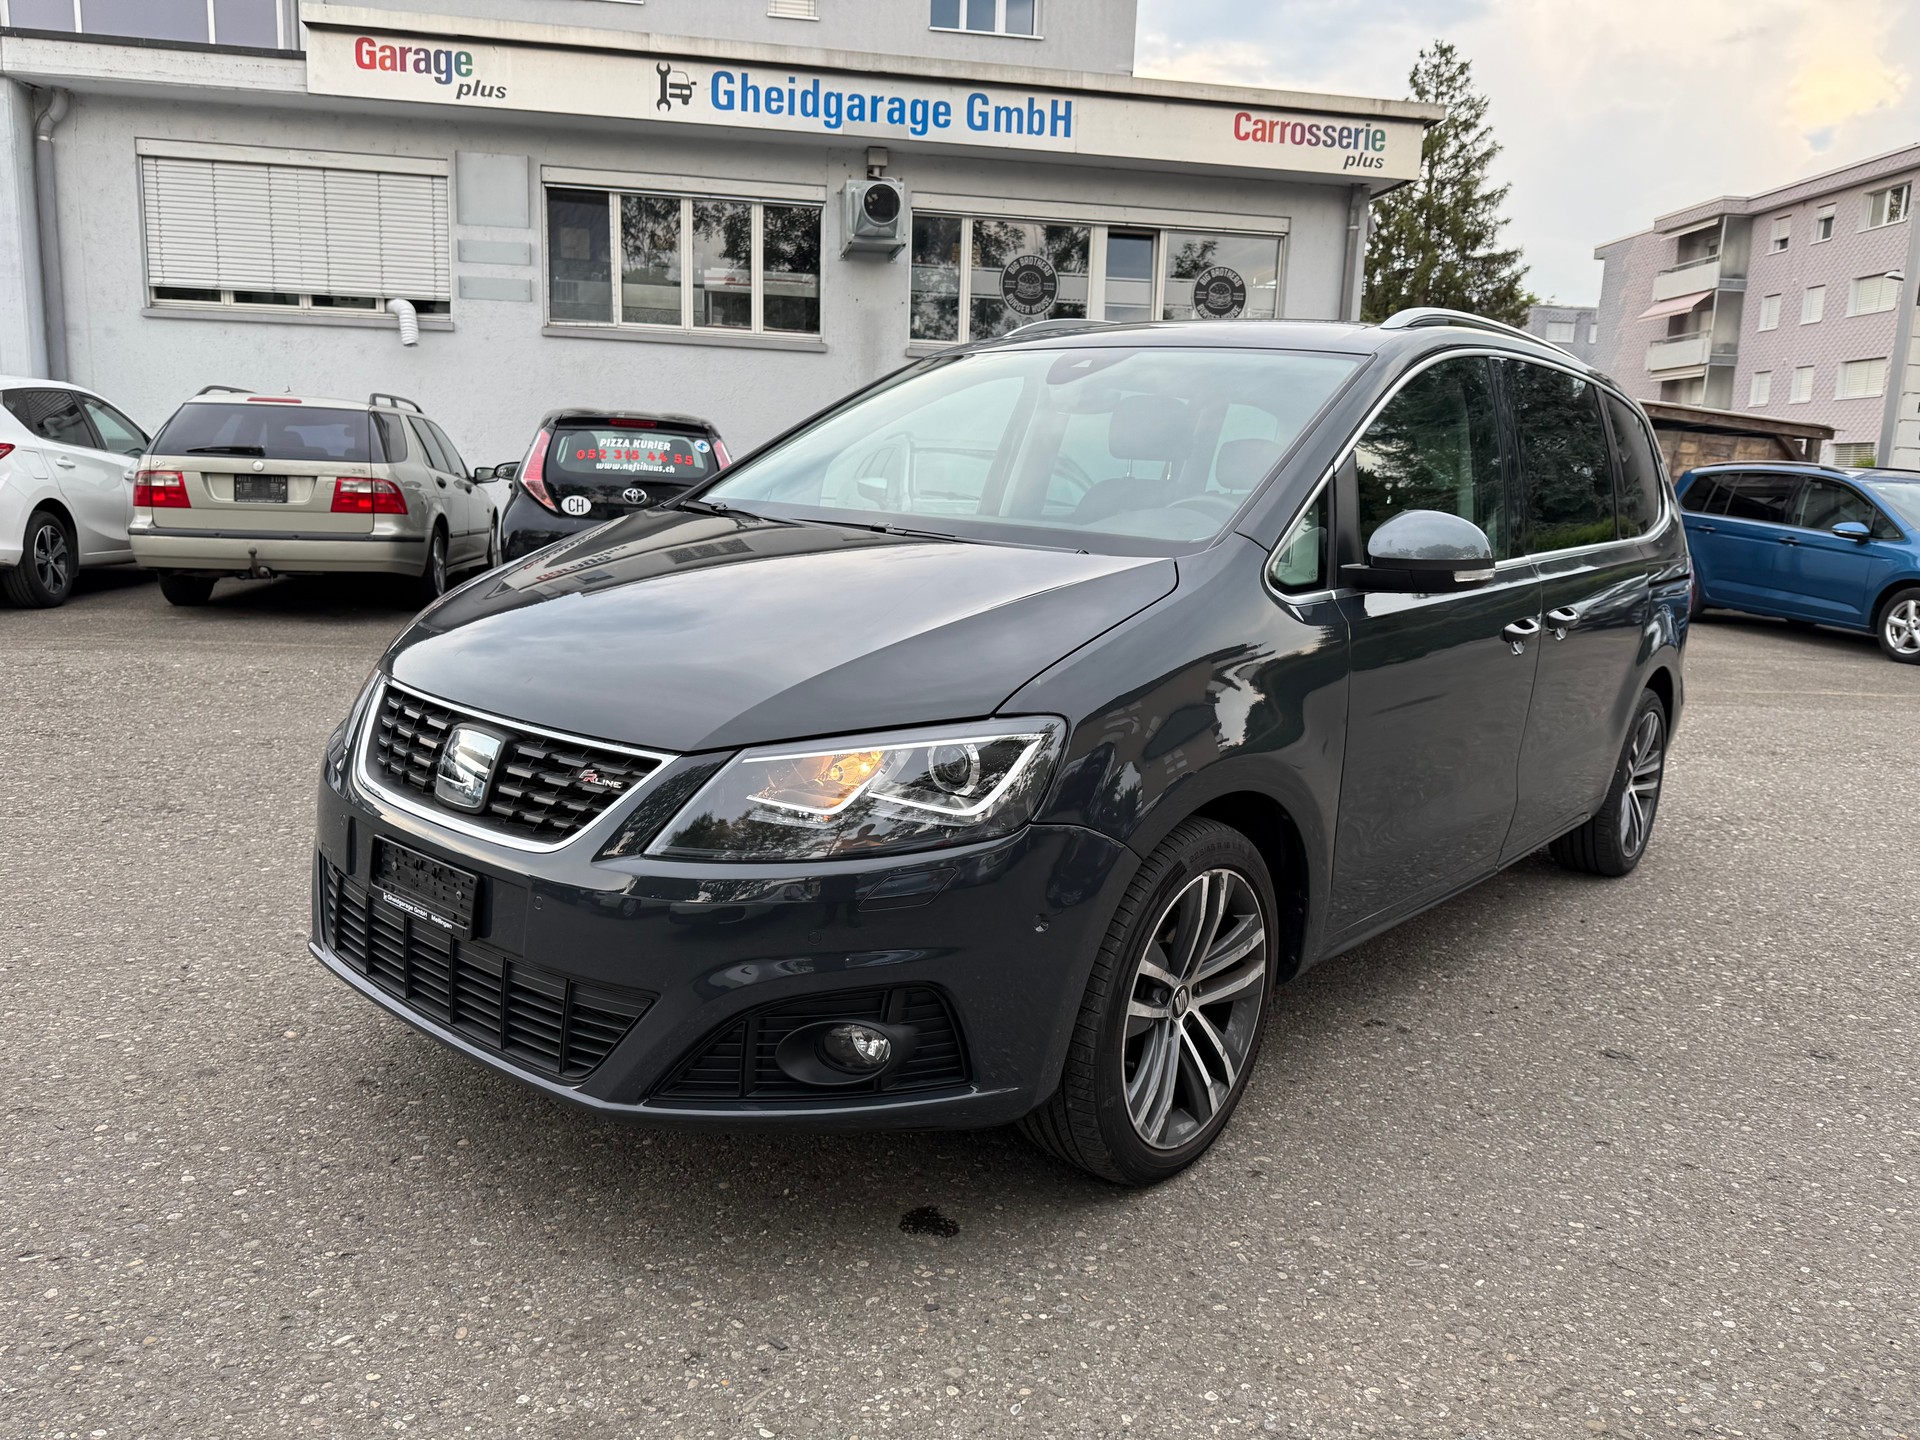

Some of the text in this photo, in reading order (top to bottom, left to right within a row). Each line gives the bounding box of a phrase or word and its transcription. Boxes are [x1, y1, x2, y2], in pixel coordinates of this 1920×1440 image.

[355, 36, 474, 85] Garage
[456, 79, 508, 100] plus
[710, 70, 1073, 138] Gheidgarage GmbH
[1233, 111, 1386, 152] Carrosserie
[1343, 151, 1385, 170] plus
[1007, 256, 1053, 277] BIG BROTHERS
[1199, 268, 1243, 287] BIG BROTHERS
[1005, 293, 1053, 314] BURGER HOUSE
[600, 438, 630, 448] PIZZA
[576, 449, 694, 466] 052 315 44 55
[568, 499, 584, 513] CH
